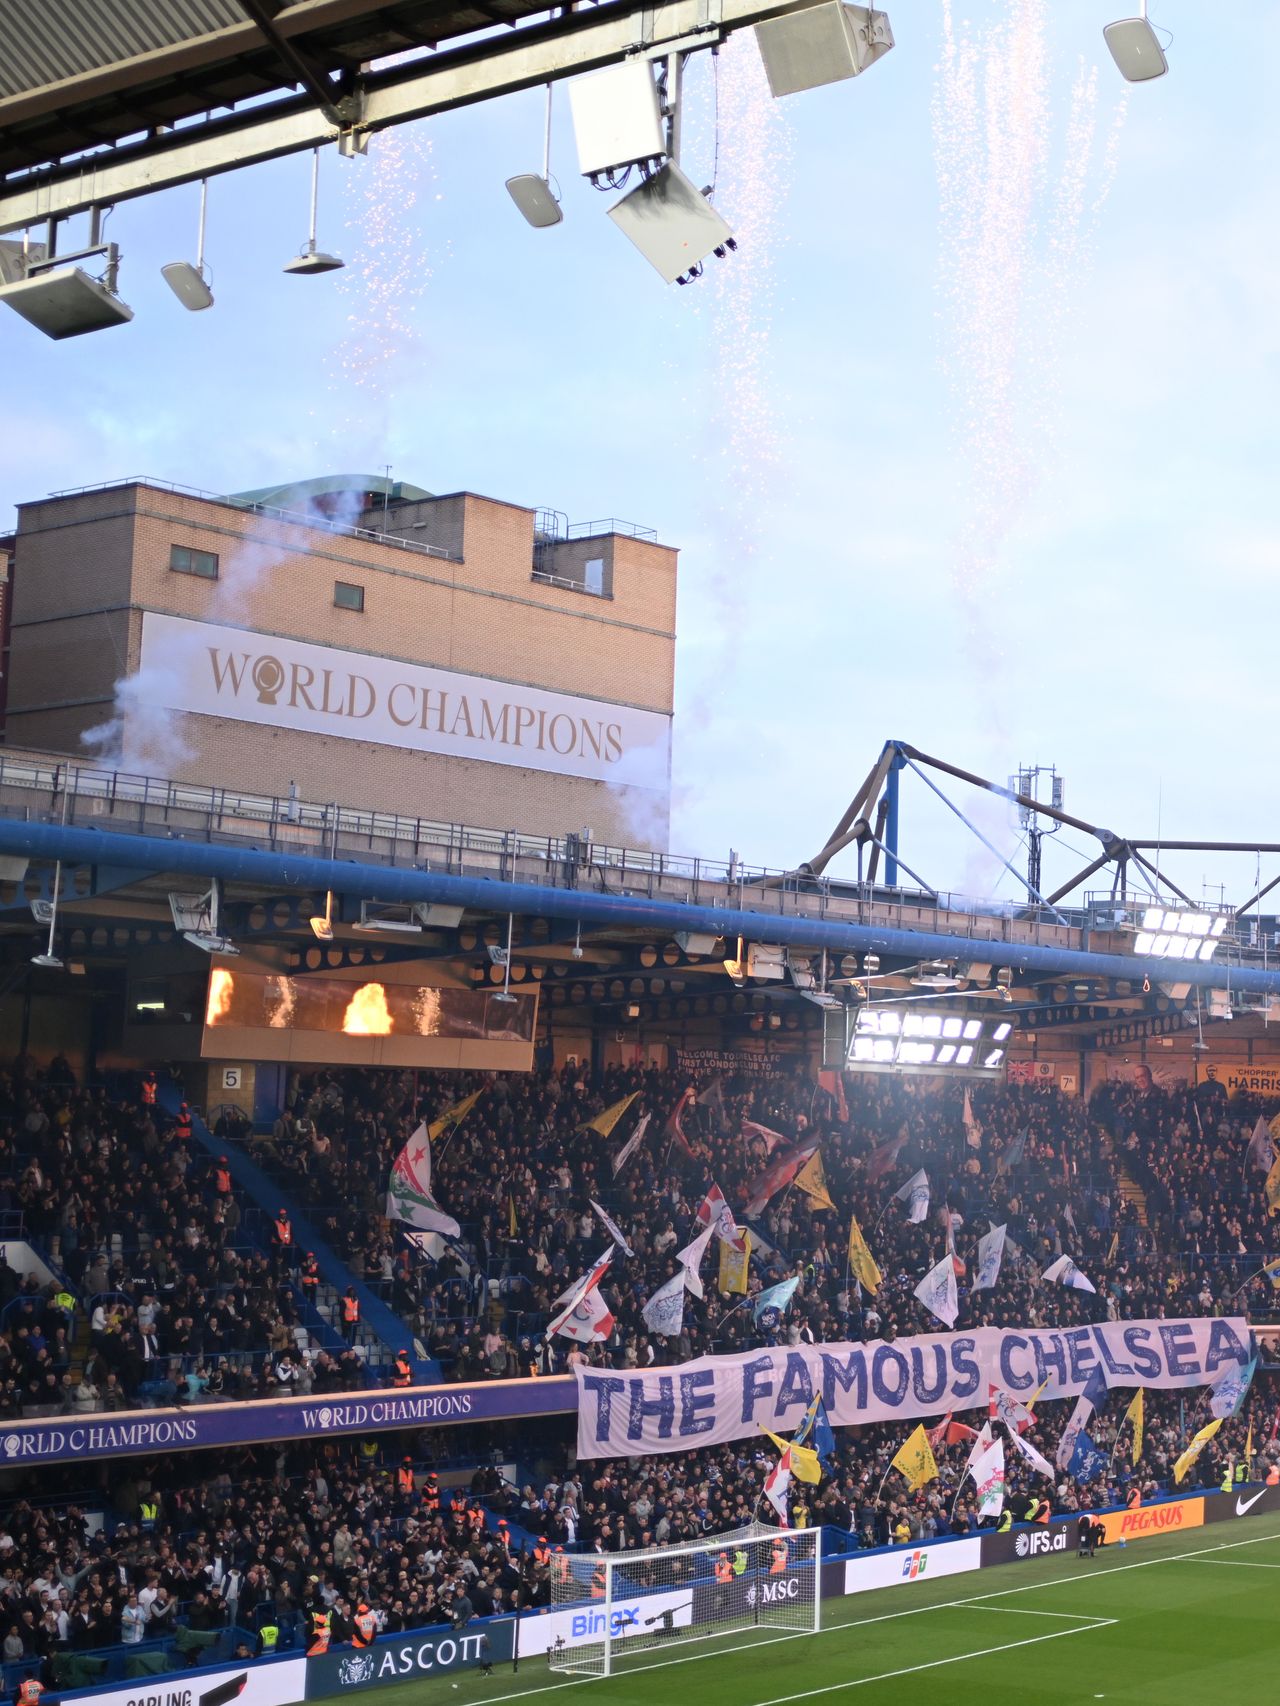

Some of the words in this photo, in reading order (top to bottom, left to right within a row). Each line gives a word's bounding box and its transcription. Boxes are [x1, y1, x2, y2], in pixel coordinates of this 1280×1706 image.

[207, 647, 377, 718] WORLD
[387, 683, 624, 763] CHAMPIONS
[676, 1049, 719, 1059] WELCOME
[677, 1057, 700, 1067] FIRST
[225, 1071, 238, 1087] 5
[583, 1369, 716, 1442] THE
[741, 1338, 980, 1424] FAMOUS
[1000, 1319, 1250, 1391] CHELSEA
[302, 1405, 368, 1428] WORLD
[371, 1394, 472, 1422] CHAMPIONS
[0, 1431, 65, 1457] ORLD
[69, 1420, 197, 1451] CHAMPIONS
[1120, 1505, 1184, 1534] PEGASUS
[1030, 1525, 1067, 1554] IFS.ai
[902, 1551, 927, 1579] FPT
[762, 1578, 799, 1603] MSC
[378, 1633, 486, 1678] ASCOTT
